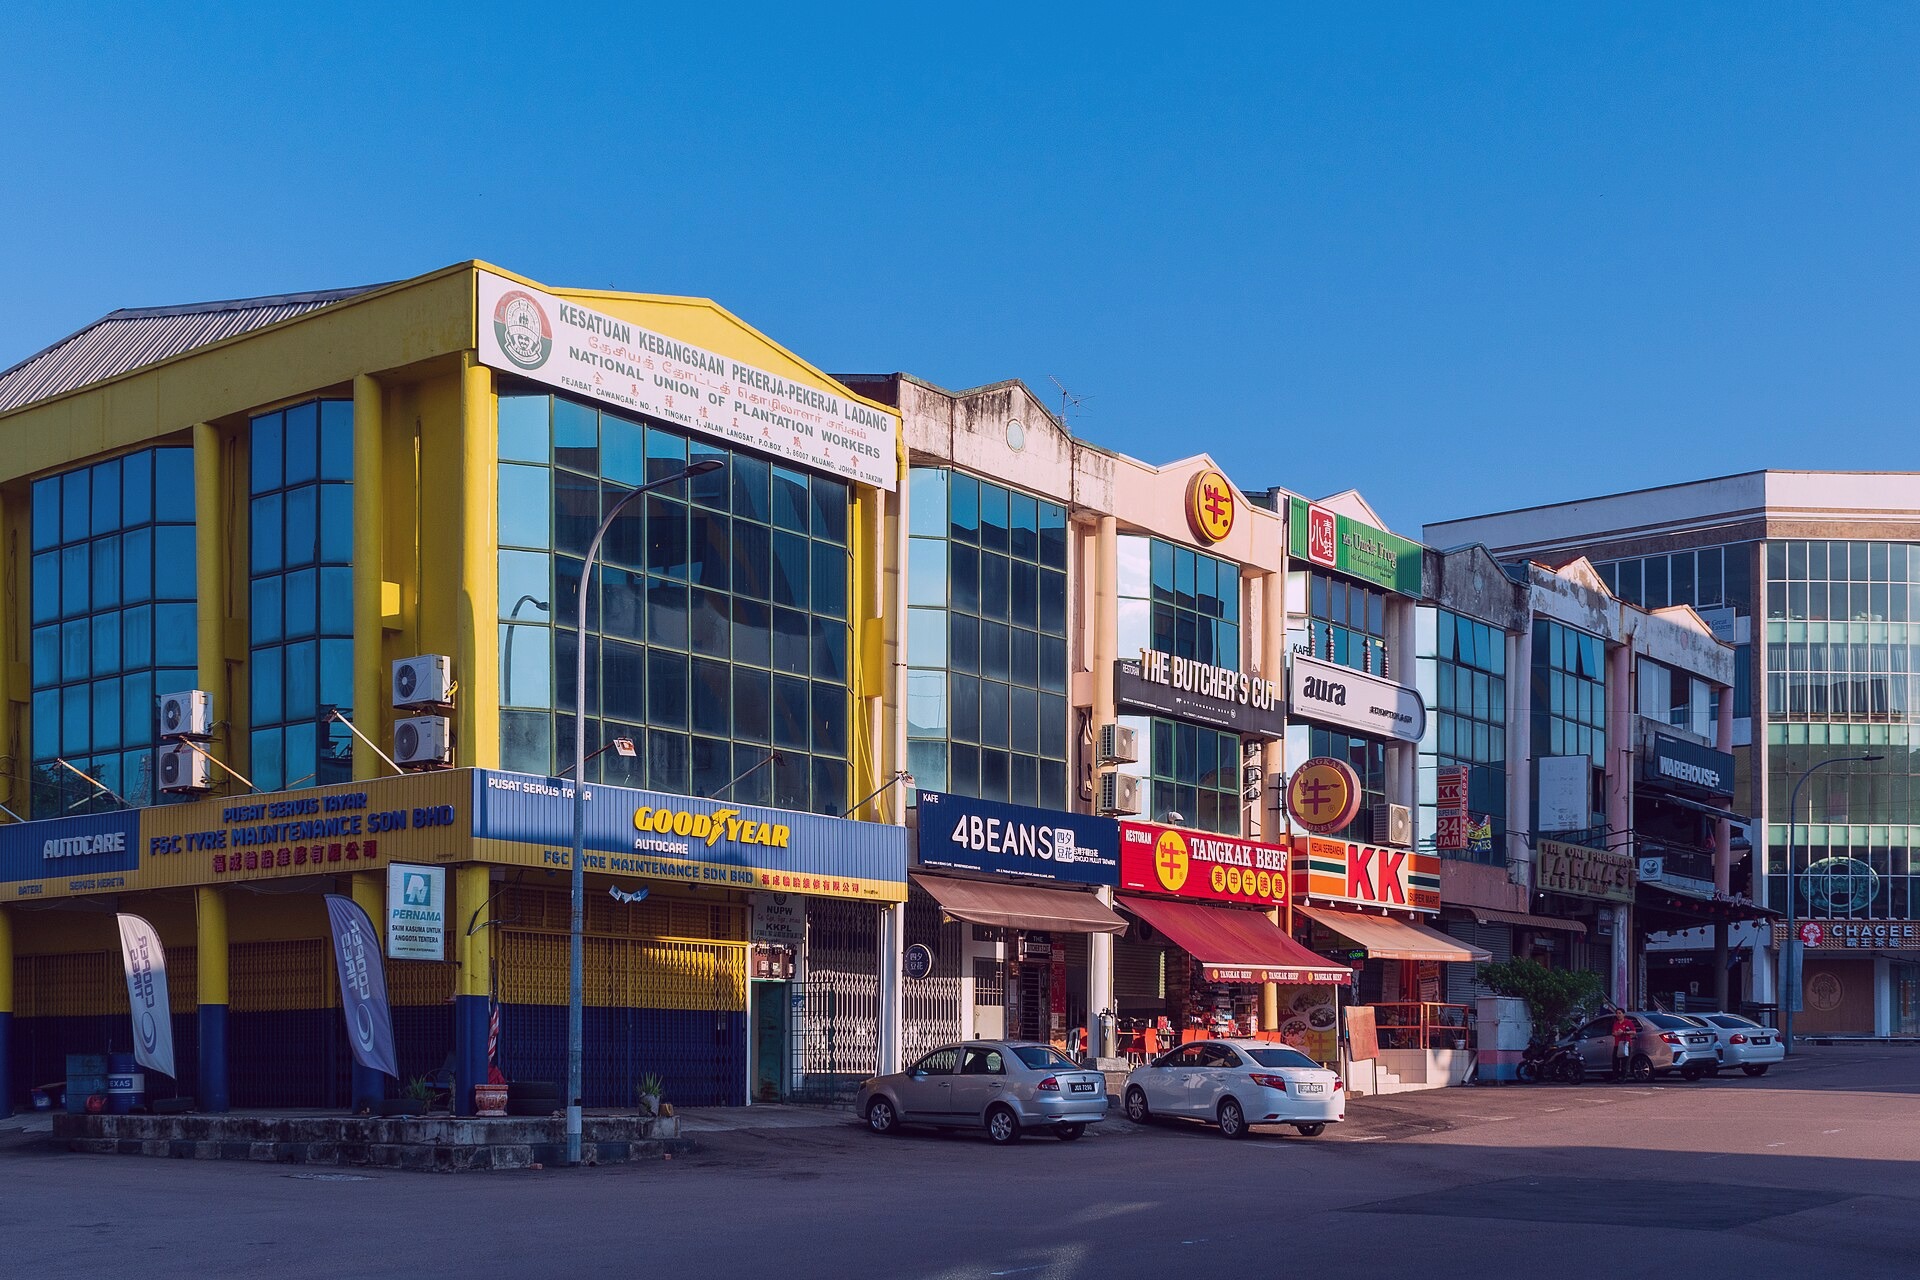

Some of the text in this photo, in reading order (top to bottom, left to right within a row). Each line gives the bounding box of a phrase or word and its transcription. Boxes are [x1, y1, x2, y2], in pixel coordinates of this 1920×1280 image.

[559, 303, 631, 345] KESATUAN
[640, 331, 725, 377] KEBANGSAAN
[732, 363, 839, 416] PEKERJA-PEKERJA
[844, 403, 888, 432] LADANG
[569, 345, 880, 459] NATIONAL UNION OF PLANTATION WORKERS
[561, 375, 592, 392] PEJABAT
[596, 387, 637, 406] CAWANGAN:
[640, 402, 651, 411] NO.
[664, 408, 692, 424] TINGKAT
[703, 421, 724, 433] JALAN
[726, 427, 756, 444] LANGSAT,
[811, 455, 836, 470] KLUANG,
[838, 464, 857, 476] JOHOR
[1378, 541, 1397, 569] Frog
[1140, 649, 1276, 711] THE BUTCHER'S CUT
[1303, 676, 1346, 707] aura
[1296, 758, 1343, 776] TANGKAK
[488, 777, 592, 801] PUSAT SERVIS TAAR
[1439, 786, 1459, 798] KK
[923, 793, 939, 803] KAFE
[223, 793, 367, 823] PUSAT SERVIS TAYAR
[185, 829, 227, 852] TYRE
[231, 815, 362, 847] MAINTENANCE
[367, 809, 407, 833] SDN
[412, 804, 455, 829] BHD
[1438, 818, 1459, 837] 24
[43, 832, 126, 859] AUTOCARE
[951, 814, 1053, 860] 4BEANS
[1126, 829, 1152, 845] RESTORAN
[1438, 836, 1459, 847] JAM
[635, 838, 689, 855] AUTOCARE
[1190, 837, 1288, 871] TANGKAK BEEF
[582, 854, 606, 869] YRE
[611, 857, 699, 878] MAINTENANCE
[703, 867, 727, 882] SDN
[730, 871, 754, 884] BHD
[1348, 843, 1406, 904] KK
[70, 879, 95, 891] SERVIS
[1409, 892, 1439, 905] SUPER MART
[393, 909, 441, 922] PERNAMA
[767, 905, 793, 915] NUPW
[766, 923, 792, 932] KKPL
[1832, 925, 1913, 937] CHAGEE
[395, 934, 418, 942] ANGGOTA
[1846, 938, 1899, 948] 霸王茶姬
[1025, 944, 1043, 952] UTCHER'S
[1220, 971, 1240, 979] TANGKAK
[1269, 971, 1287, 980] TANGKAK
[1314, 973, 1333, 981] TANGKAK
